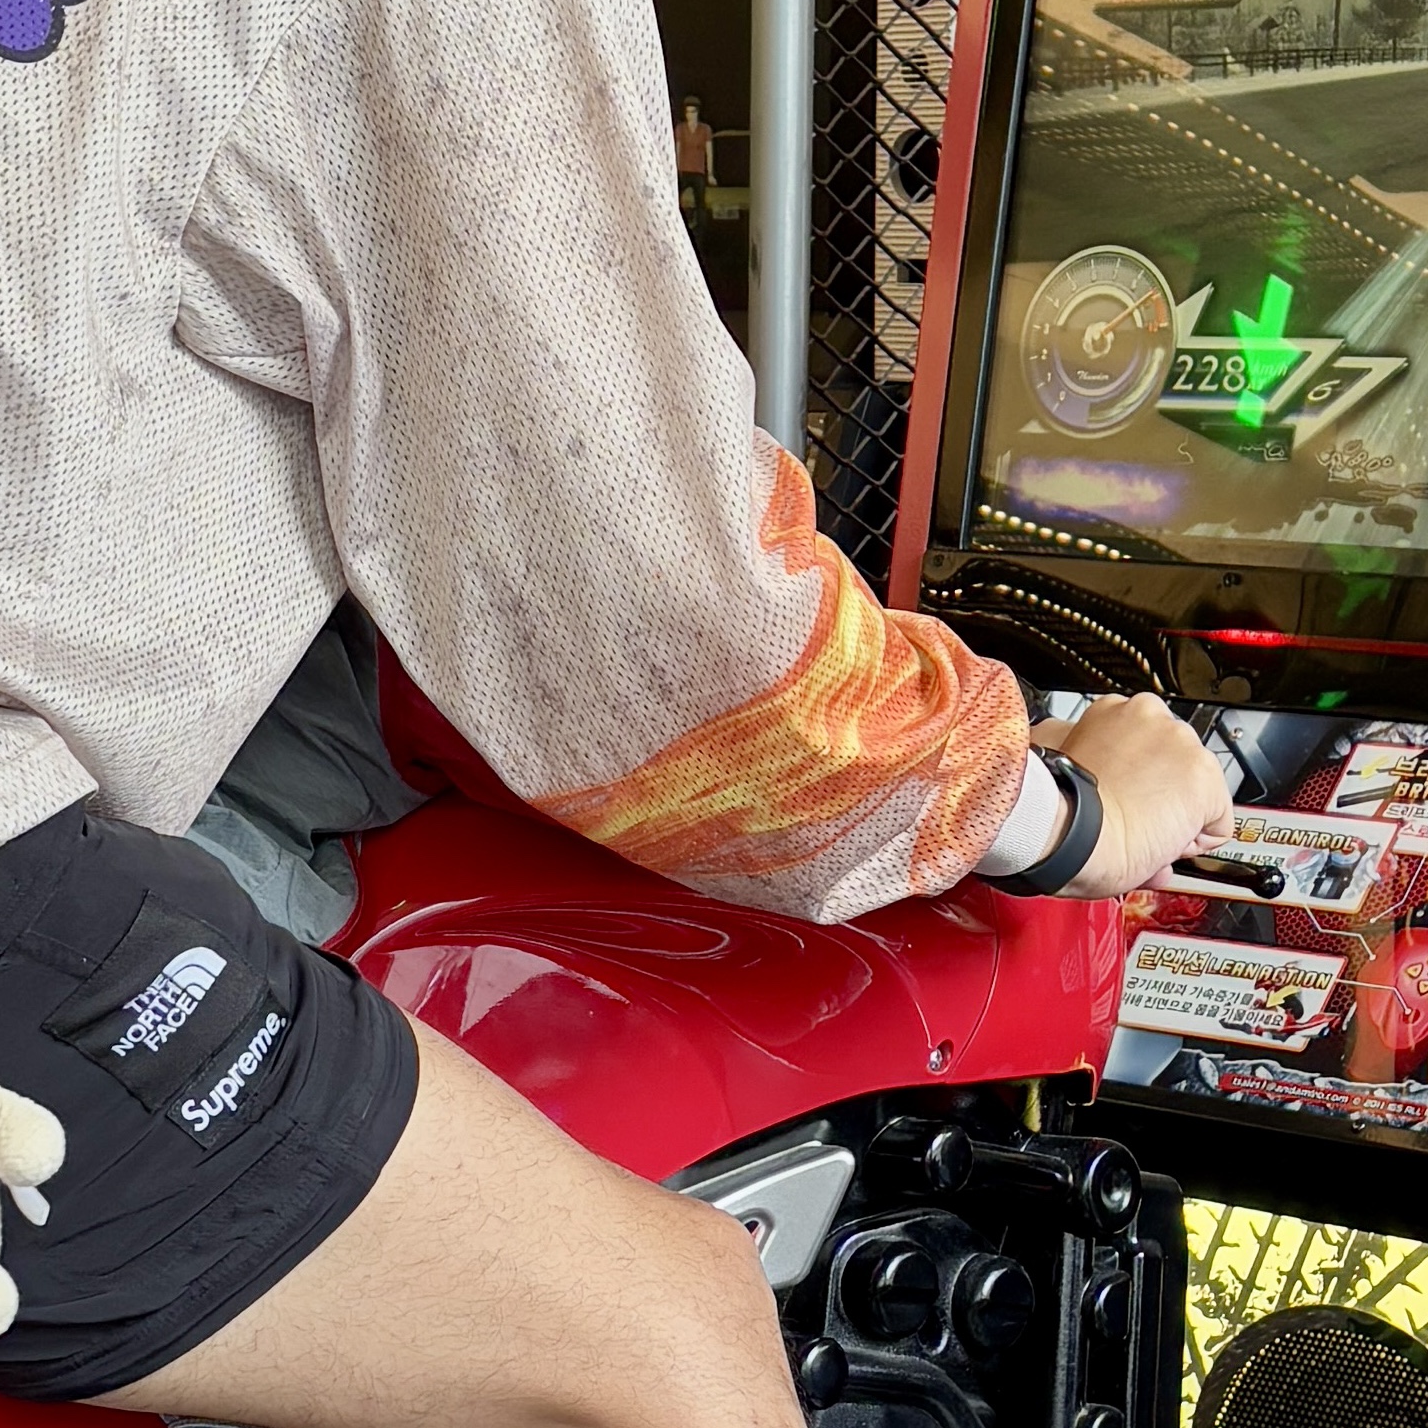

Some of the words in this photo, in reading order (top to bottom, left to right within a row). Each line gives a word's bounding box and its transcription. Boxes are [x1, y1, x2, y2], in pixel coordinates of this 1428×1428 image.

[1173, 355, 1246, 391] 228
[1263, 826, 1357, 852] CONTROL
[1209, 957, 1259, 979] LEAN
[1257, 966, 1333, 989] ACTION
[123, 974, 169, 1014] THE
[111, 980, 184, 1058] NORTH
[143, 997, 198, 1053] FACE
